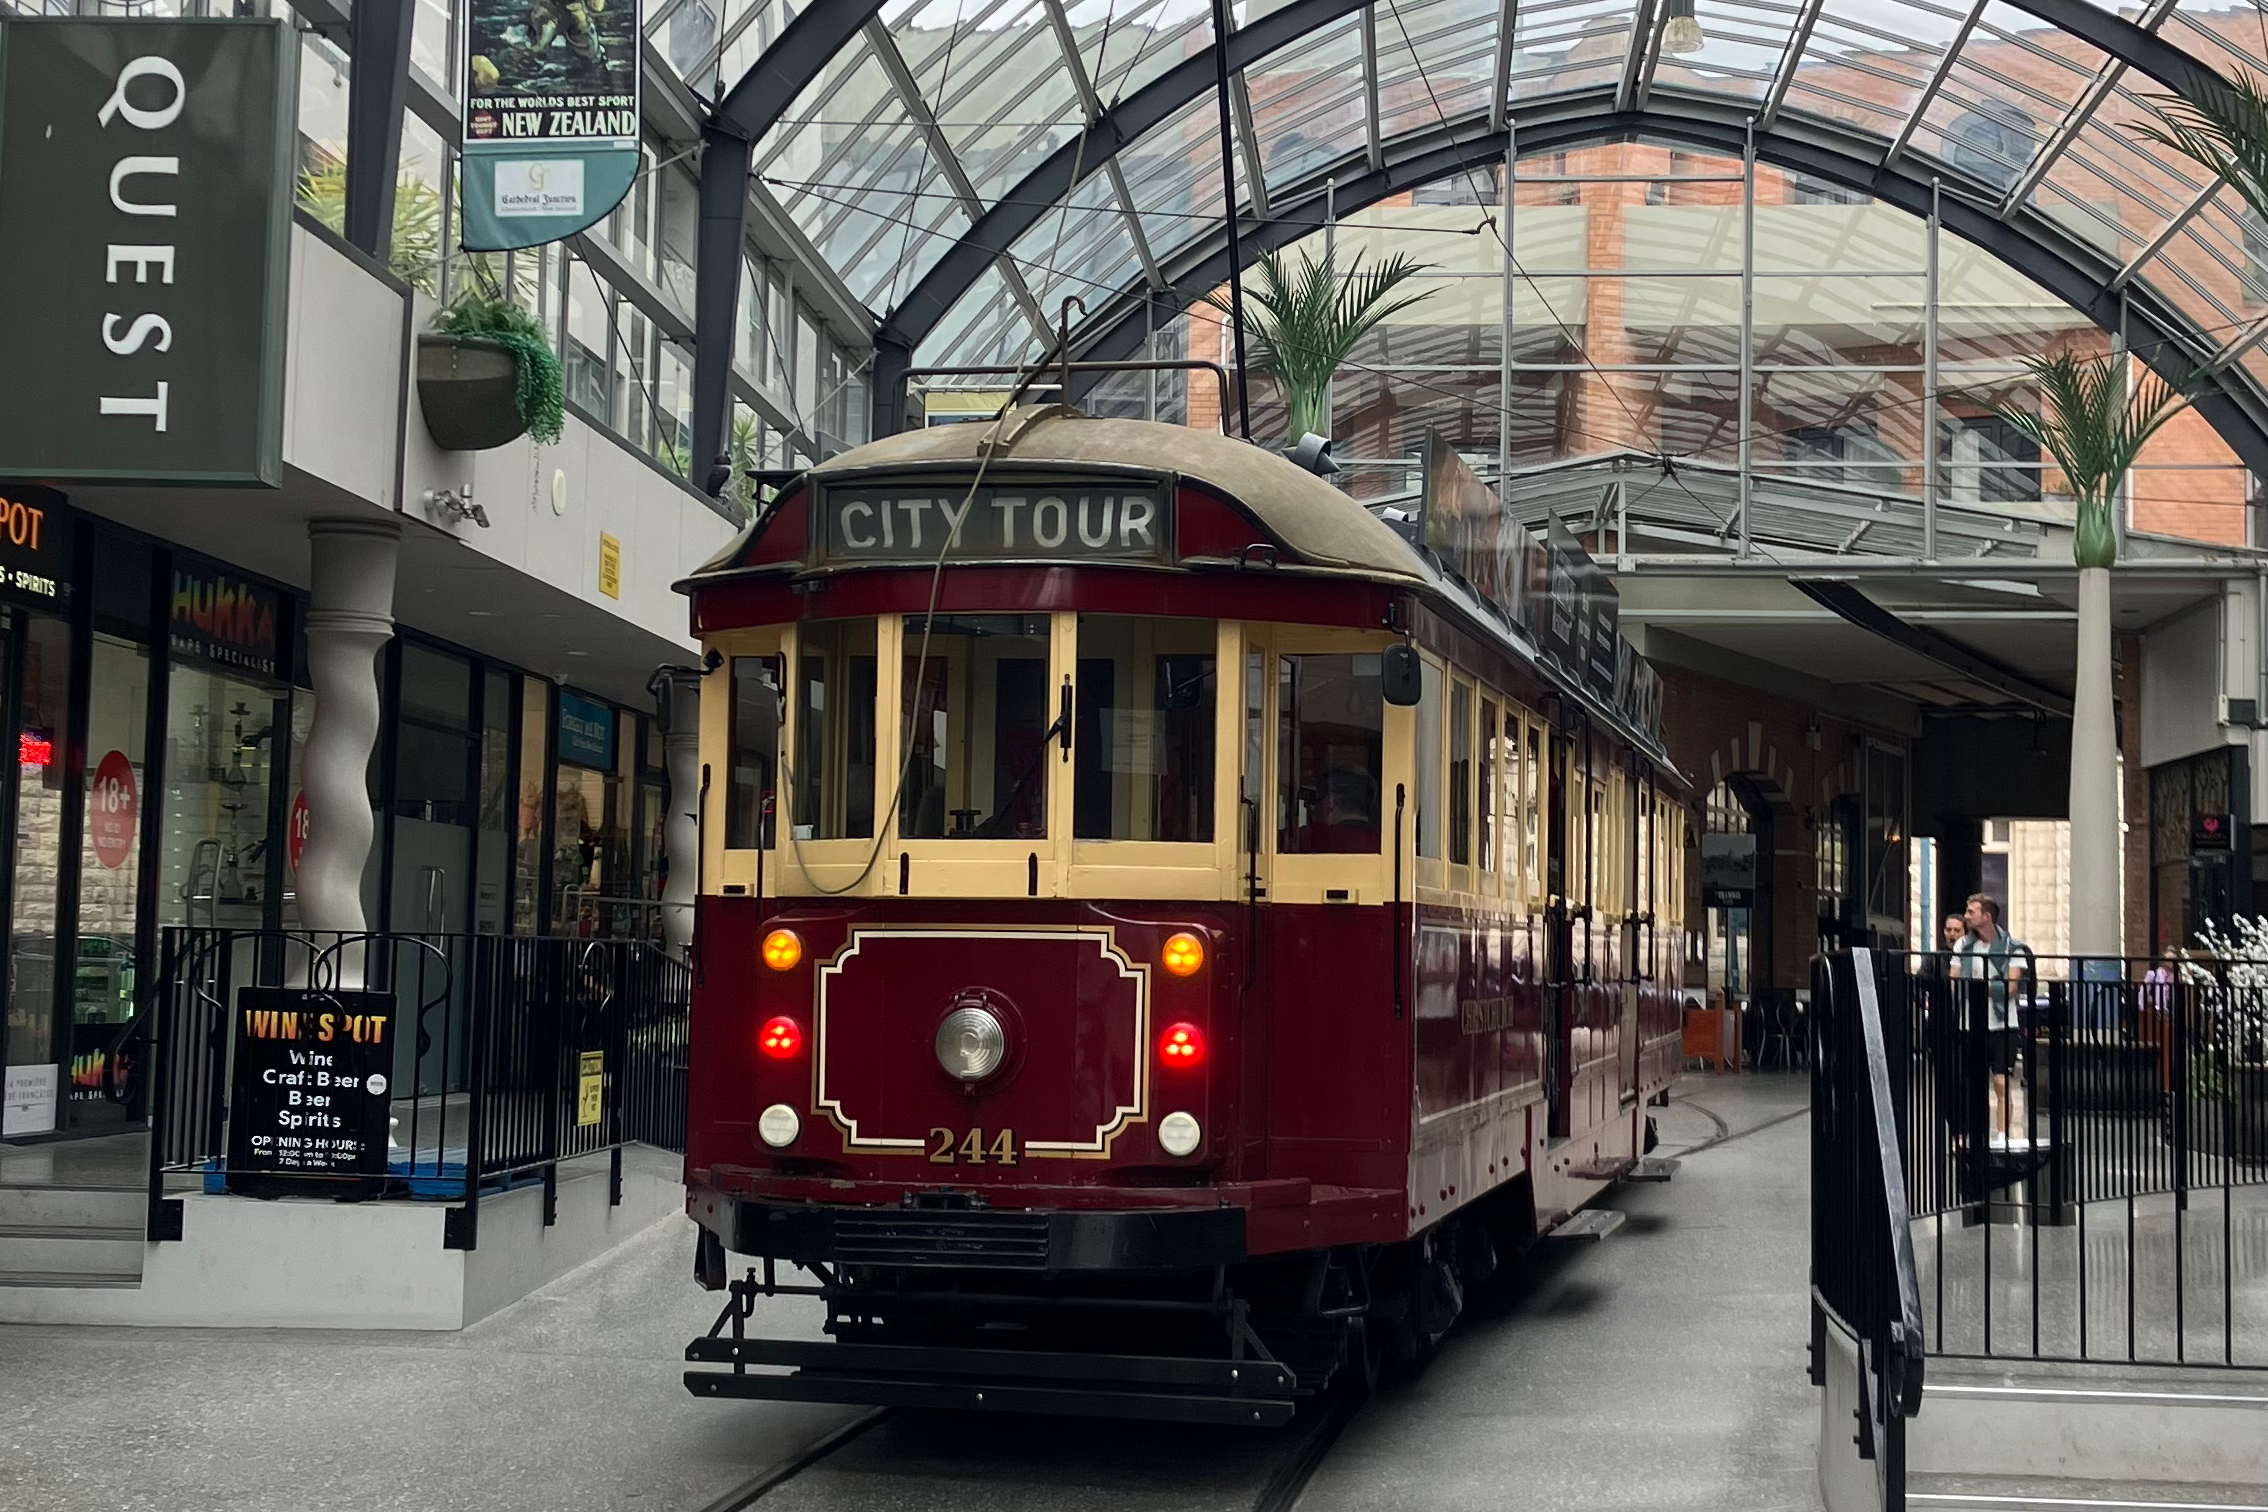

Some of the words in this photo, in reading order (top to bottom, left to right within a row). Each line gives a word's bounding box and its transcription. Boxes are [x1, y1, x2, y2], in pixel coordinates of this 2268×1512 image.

[470, 98, 493, 110] FOR
[494, 97, 515, 109] THE
[517, 96, 563, 109] WORLDS
[567, 96, 595, 108] BEST
[598, 95, 635, 107] SPORT
[502, 111, 542, 137] NEW
[549, 110, 636, 136] ZEALAND
[97, 55, 186, 432] QUEST
[840, 497, 973, 549] CITY
[991, 496, 1157, 548] TOUR
[15, 570, 56, 597] SPIRITS
[208, 644, 275, 674] SPECIALIST
[99, 776, 131, 813] 18+
[317, 1071, 360, 1088] Beer
[289, 1090, 331, 1107] Beer
[278, 1110, 342, 1129] Spirits
[251, 1135, 313, 1149] OPNING
[930, 1127, 1018, 1165] 244
